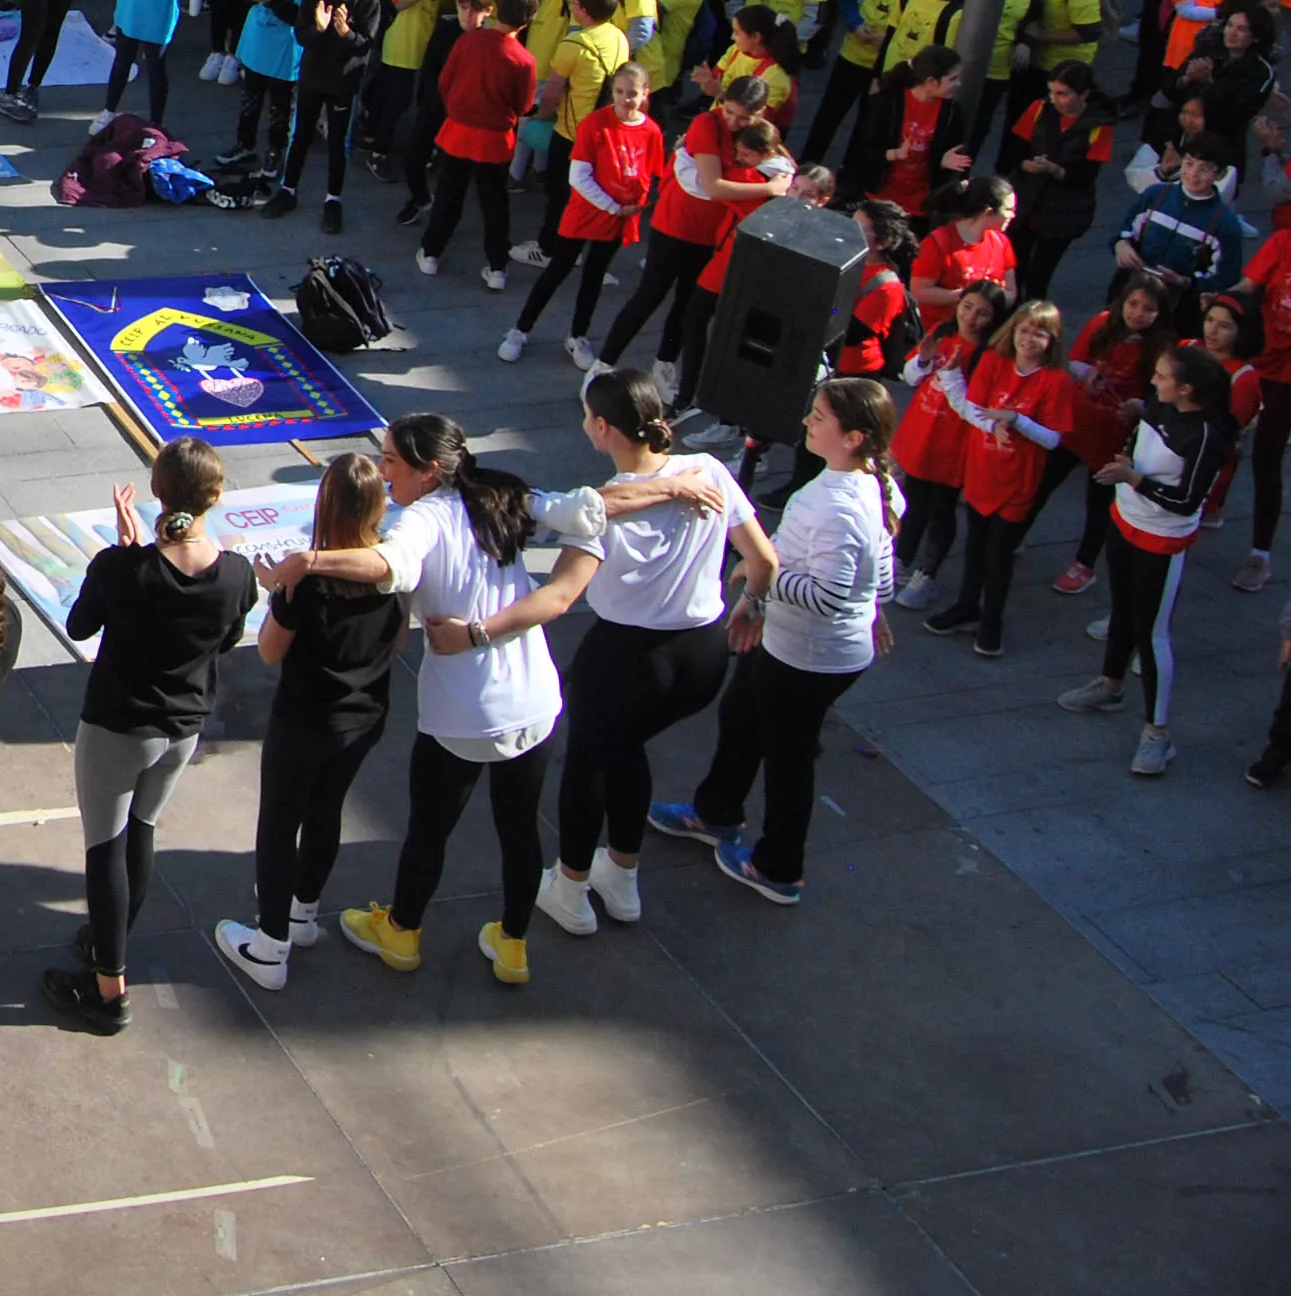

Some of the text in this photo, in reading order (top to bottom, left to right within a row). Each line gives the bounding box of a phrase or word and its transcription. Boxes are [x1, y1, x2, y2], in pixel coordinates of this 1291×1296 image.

[119, 326, 145, 348] CEIP
[154, 313, 173, 327] AL
[225, 505, 280, 530] CEIP
